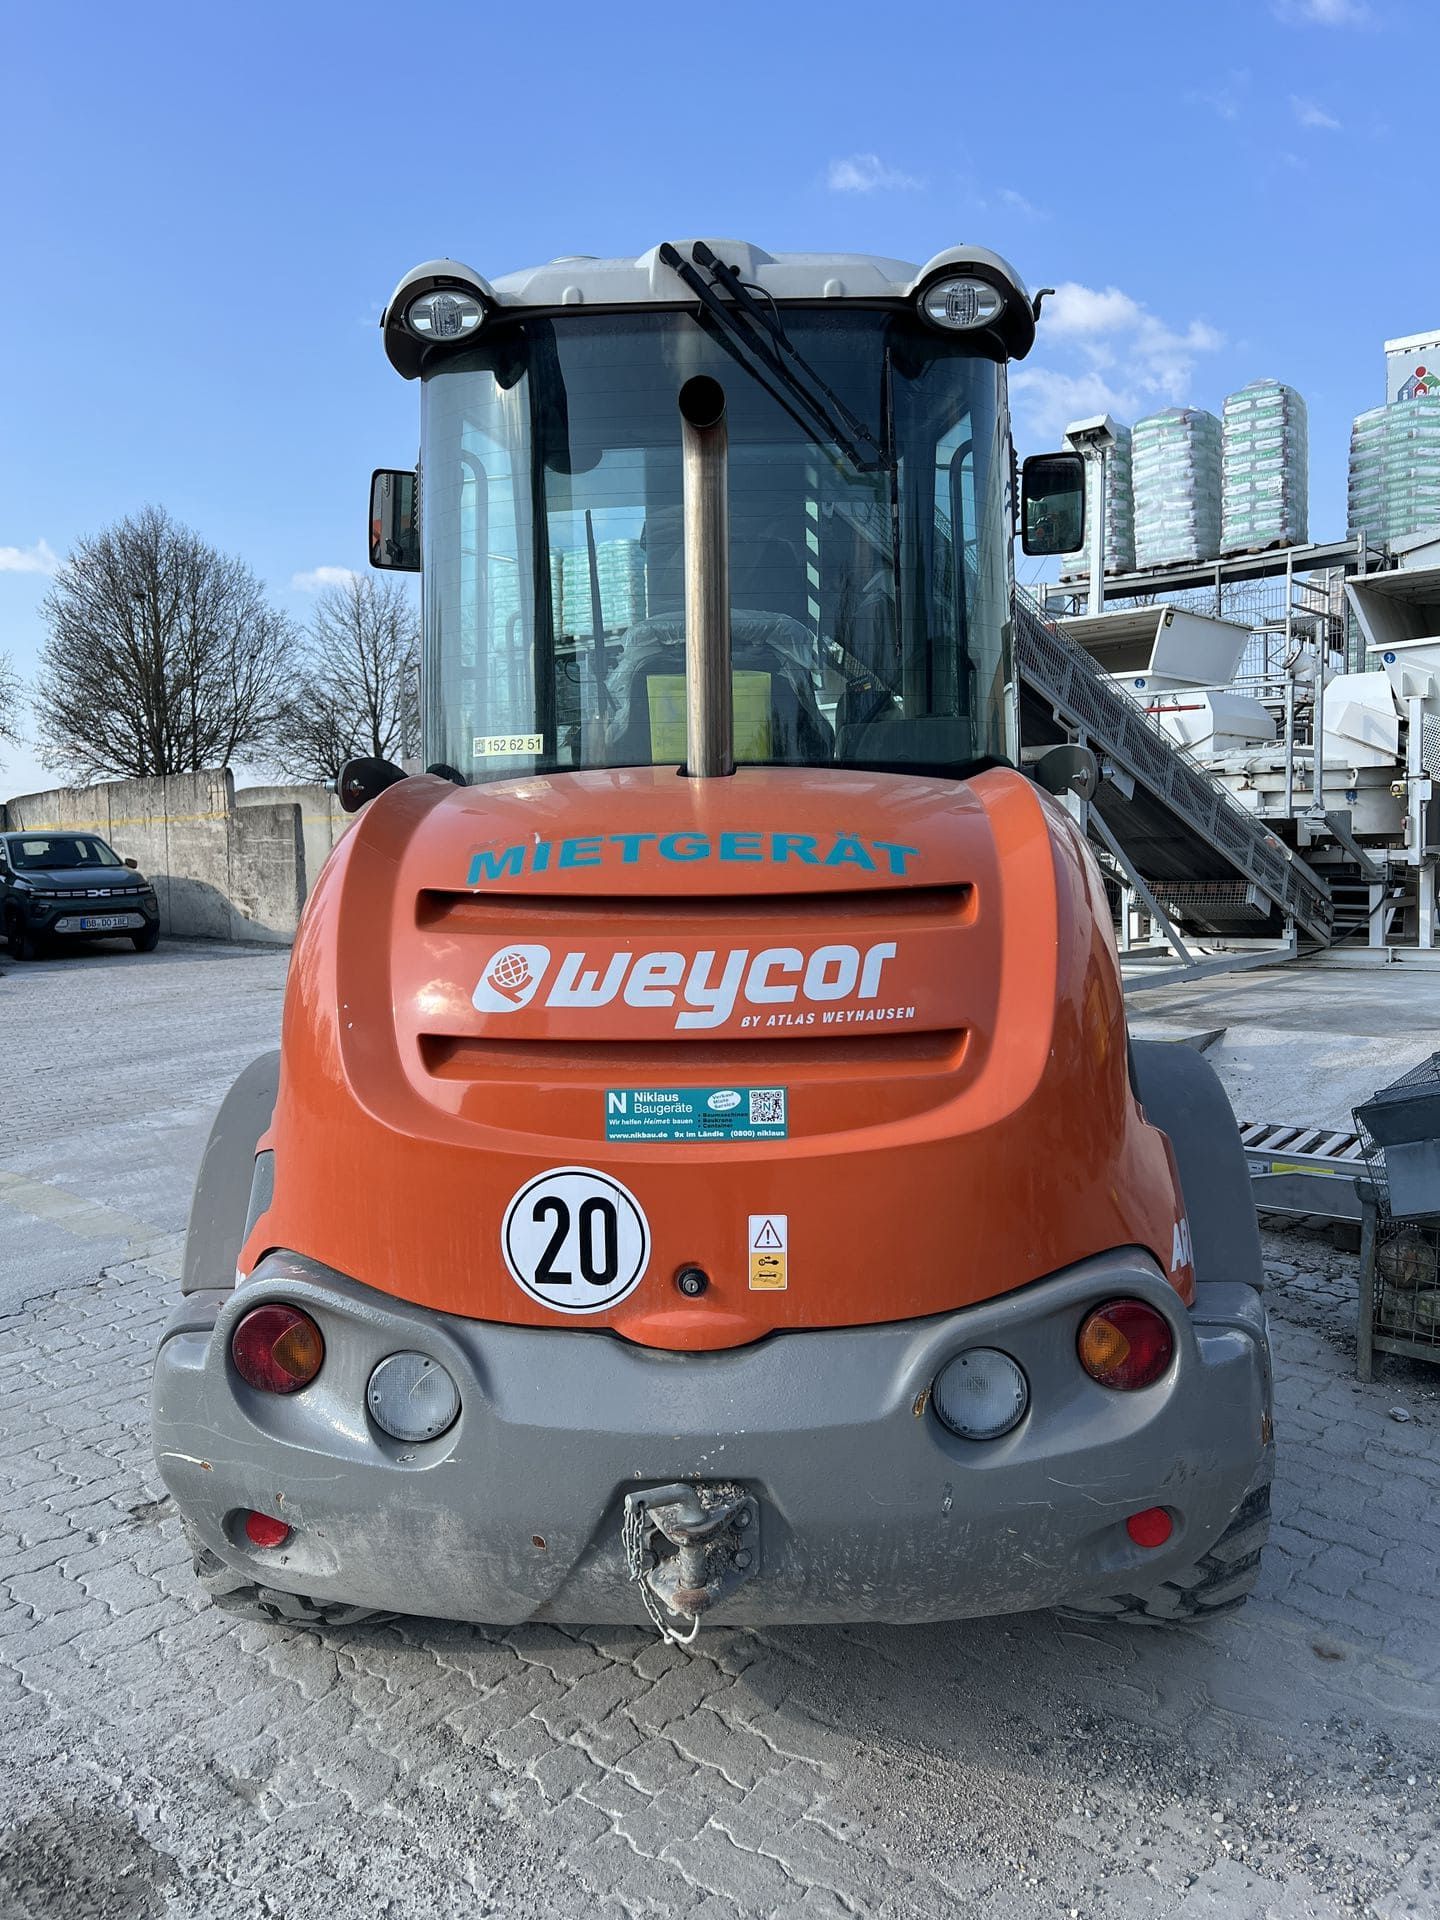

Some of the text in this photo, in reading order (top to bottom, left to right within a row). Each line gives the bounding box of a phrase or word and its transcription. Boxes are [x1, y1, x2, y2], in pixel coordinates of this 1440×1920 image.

[488, 739, 541, 751] 152 62 51
[467, 832, 920, 885] MIETGERÄT
[545, 942, 896, 1029] weycor
[740, 1007, 915, 1028] BY ATLAS WEYHAUSEN
[608, 1092, 627, 1114] N
[634, 1092, 679, 1102] Niklaus
[634, 1103, 693, 1116] Baugeräte
[672, 1117, 694, 1125] bauen
[609, 1131, 668, 1139] www.nikbau.de
[730, 1129, 755, 1138] (0800)
[757, 1129, 785, 1137] niklaus
[532, 1196, 618, 1286] 20
